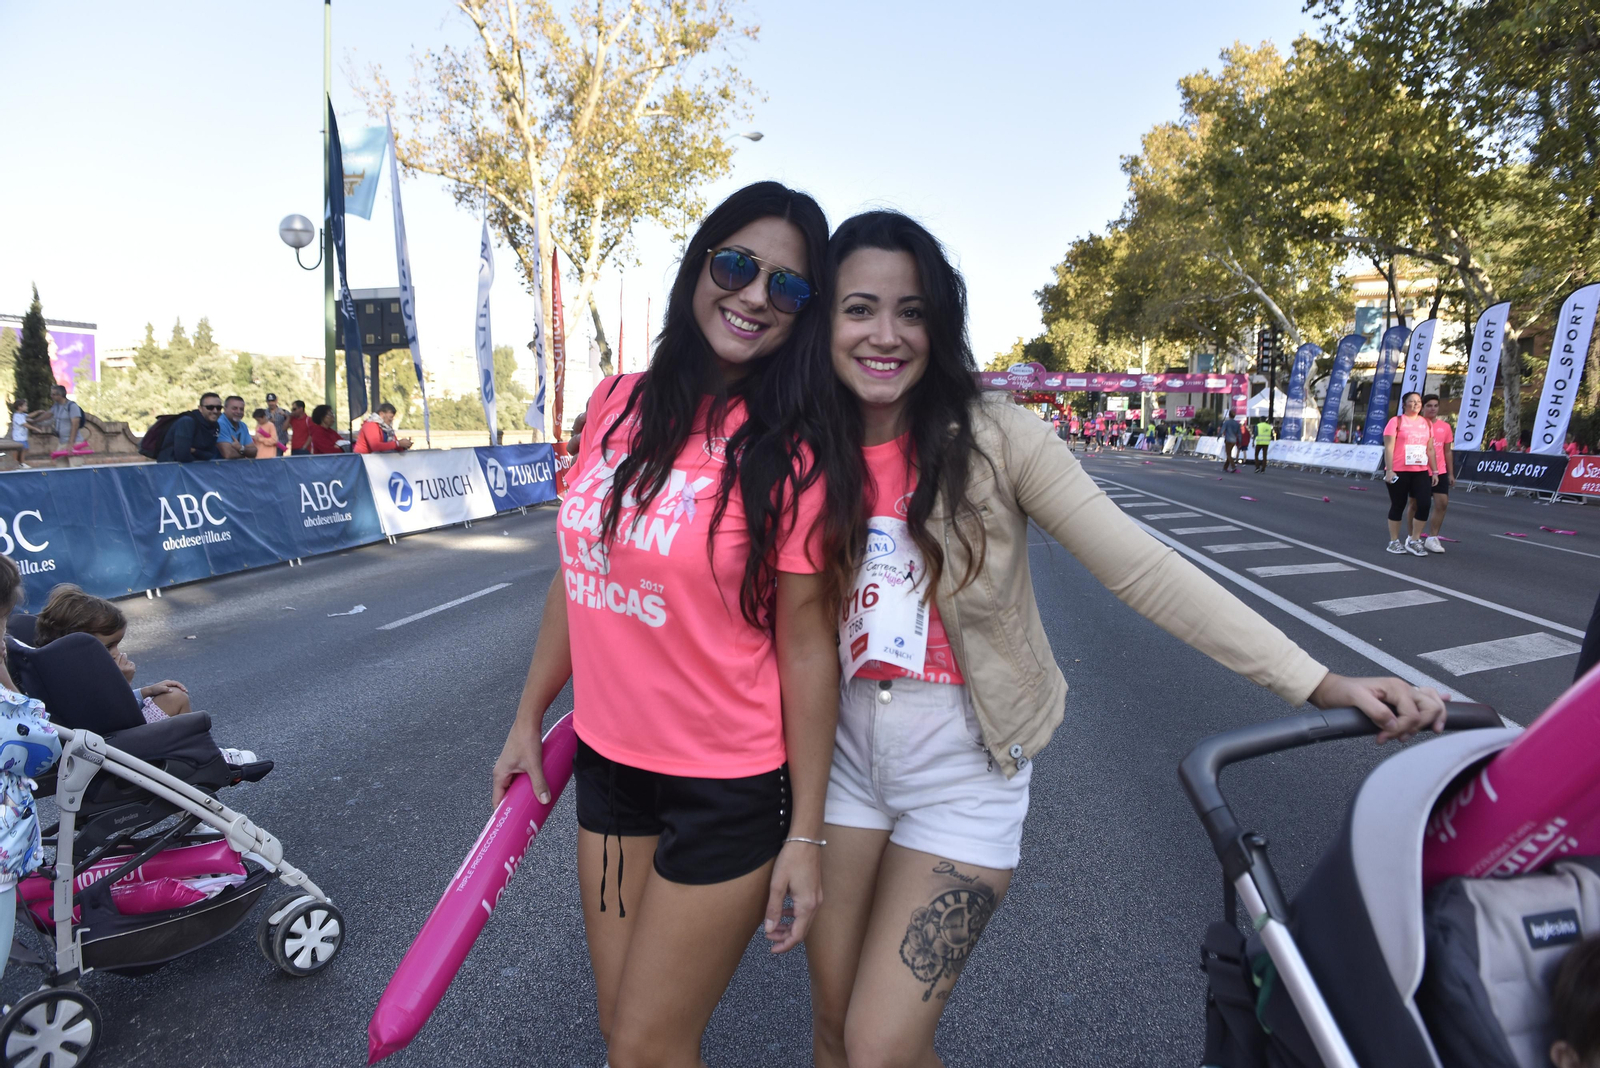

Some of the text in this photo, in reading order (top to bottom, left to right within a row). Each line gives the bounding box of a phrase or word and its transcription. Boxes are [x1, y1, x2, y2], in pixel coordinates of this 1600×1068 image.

[1463, 319, 1497, 442] OYSHO_SPORT
[1543, 303, 1585, 445] OYSHO_SPORT
[507, 461, 553, 487] ZURICH
[1476, 460, 1548, 478] OYSHO_SPORT
[299, 479, 348, 513] ABC
[415, 475, 474, 501] ZURICH
[158, 491, 227, 534] ABC
[303, 512, 353, 528] abcdesevilla.es
[561, 496, 681, 557] GAAN
[162, 530, 232, 551] abcdesevilla.es
[559, 530, 610, 575] LAS
[866, 561, 897, 573] Carrera
[882, 570, 906, 587] Mujer
[565, 568, 667, 628] CHICAS
[640, 578, 665, 595] 2017
[883, 646, 912, 661] ZURICH
[113, 812, 139, 825] Inglesina
[456, 806, 513, 892] TRIPLE PROTECCION SOLAR
[932, 861, 980, 884] Daniel
[1530, 918, 1577, 941] Inglesina
